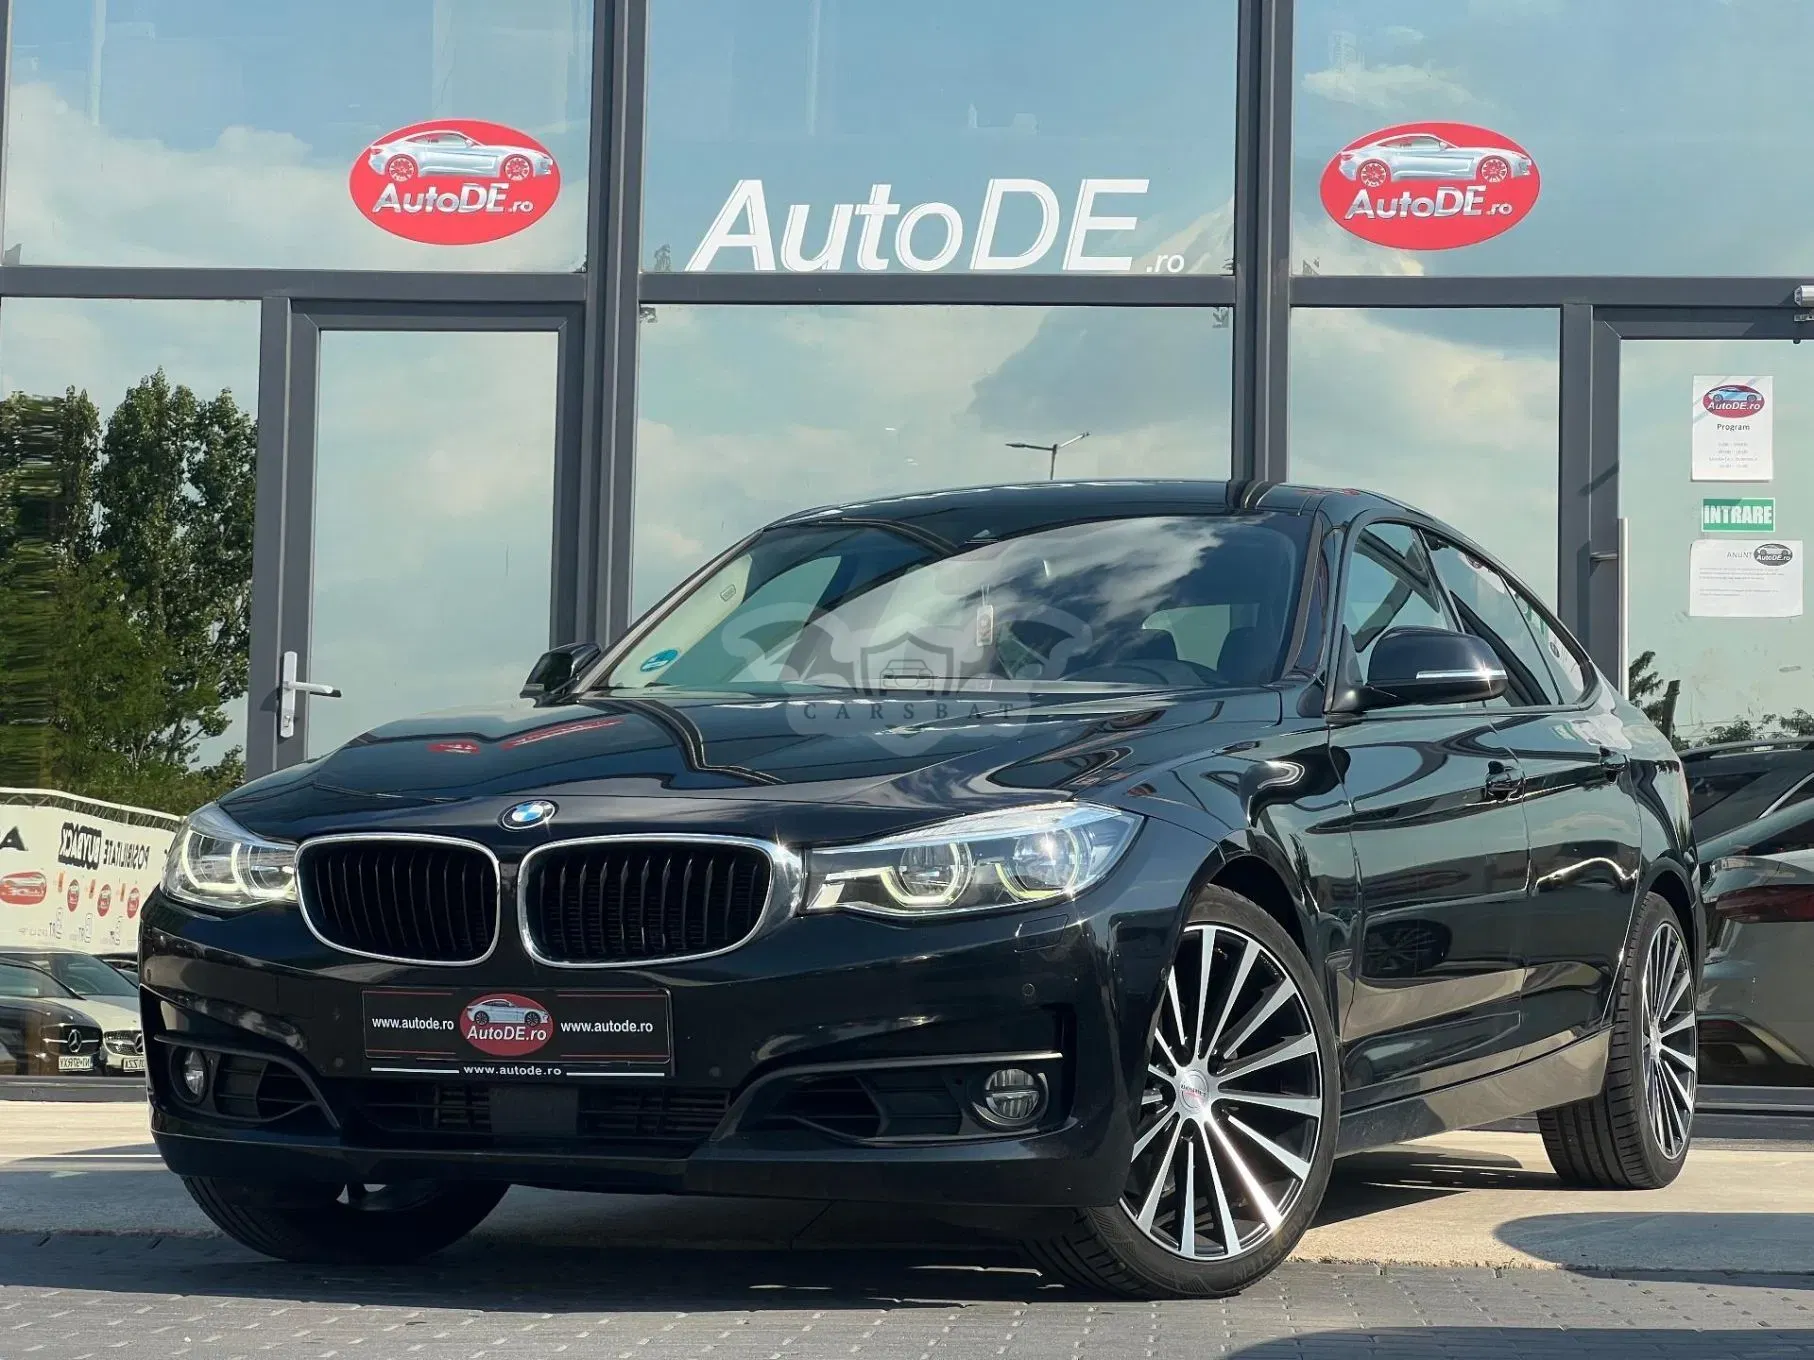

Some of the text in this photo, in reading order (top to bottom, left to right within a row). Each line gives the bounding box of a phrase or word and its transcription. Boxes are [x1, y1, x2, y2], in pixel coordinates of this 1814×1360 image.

[371, 182, 534, 214] AutoDE.ro
[1344, 185, 1513, 220] AutoDE.ro
[1707, 401, 1761, 410] AutoDE.ro
[1716, 423, 1751, 431] Program
[1703, 505, 1773, 524] INTRARE
[371, 1016, 455, 1031] www.autode.ro
[560, 1019, 654, 1034] www.autode.ro
[466, 1025, 548, 1042] AutoDE.ro
[463, 1065, 562, 1076] www.autode.ro
